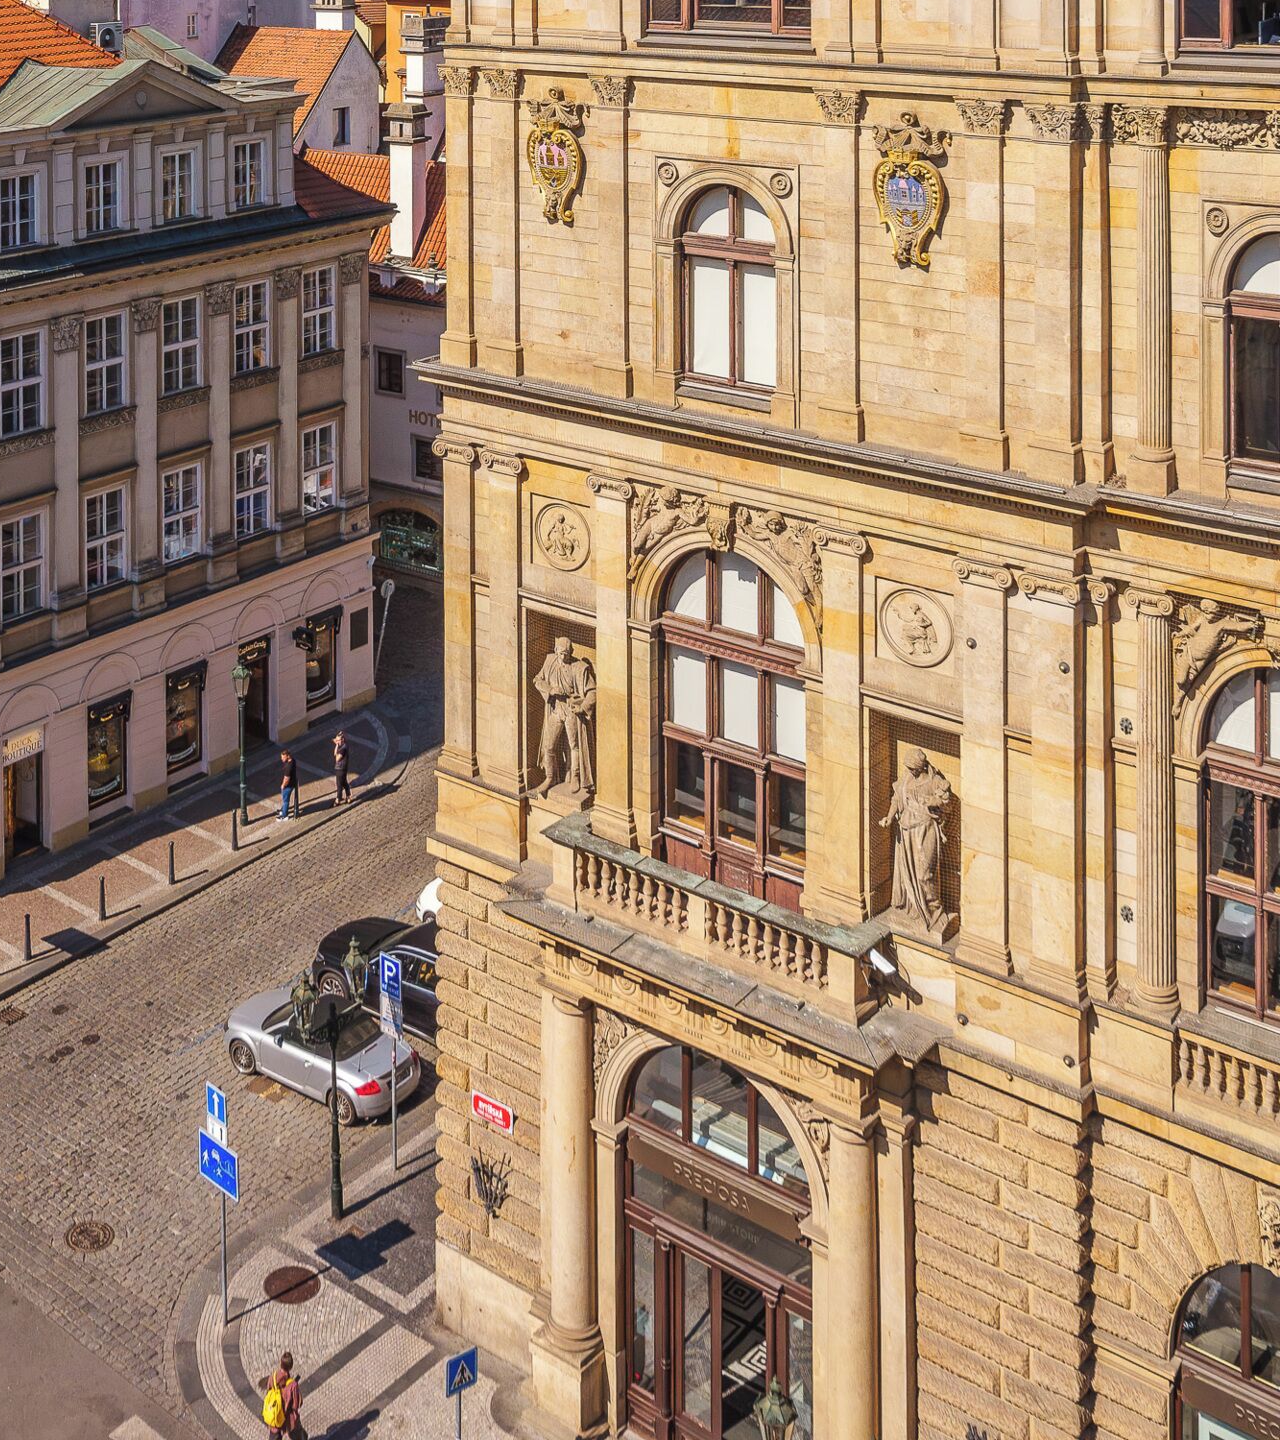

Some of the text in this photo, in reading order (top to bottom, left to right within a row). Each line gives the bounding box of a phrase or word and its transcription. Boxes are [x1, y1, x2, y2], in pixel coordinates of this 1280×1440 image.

[2, 740, 43, 763] BOUTIQUE
[10, 736, 32, 753] DUCK
[384, 959, 396, 984] P
[672, 1160, 751, 1214] PRECIOSA
